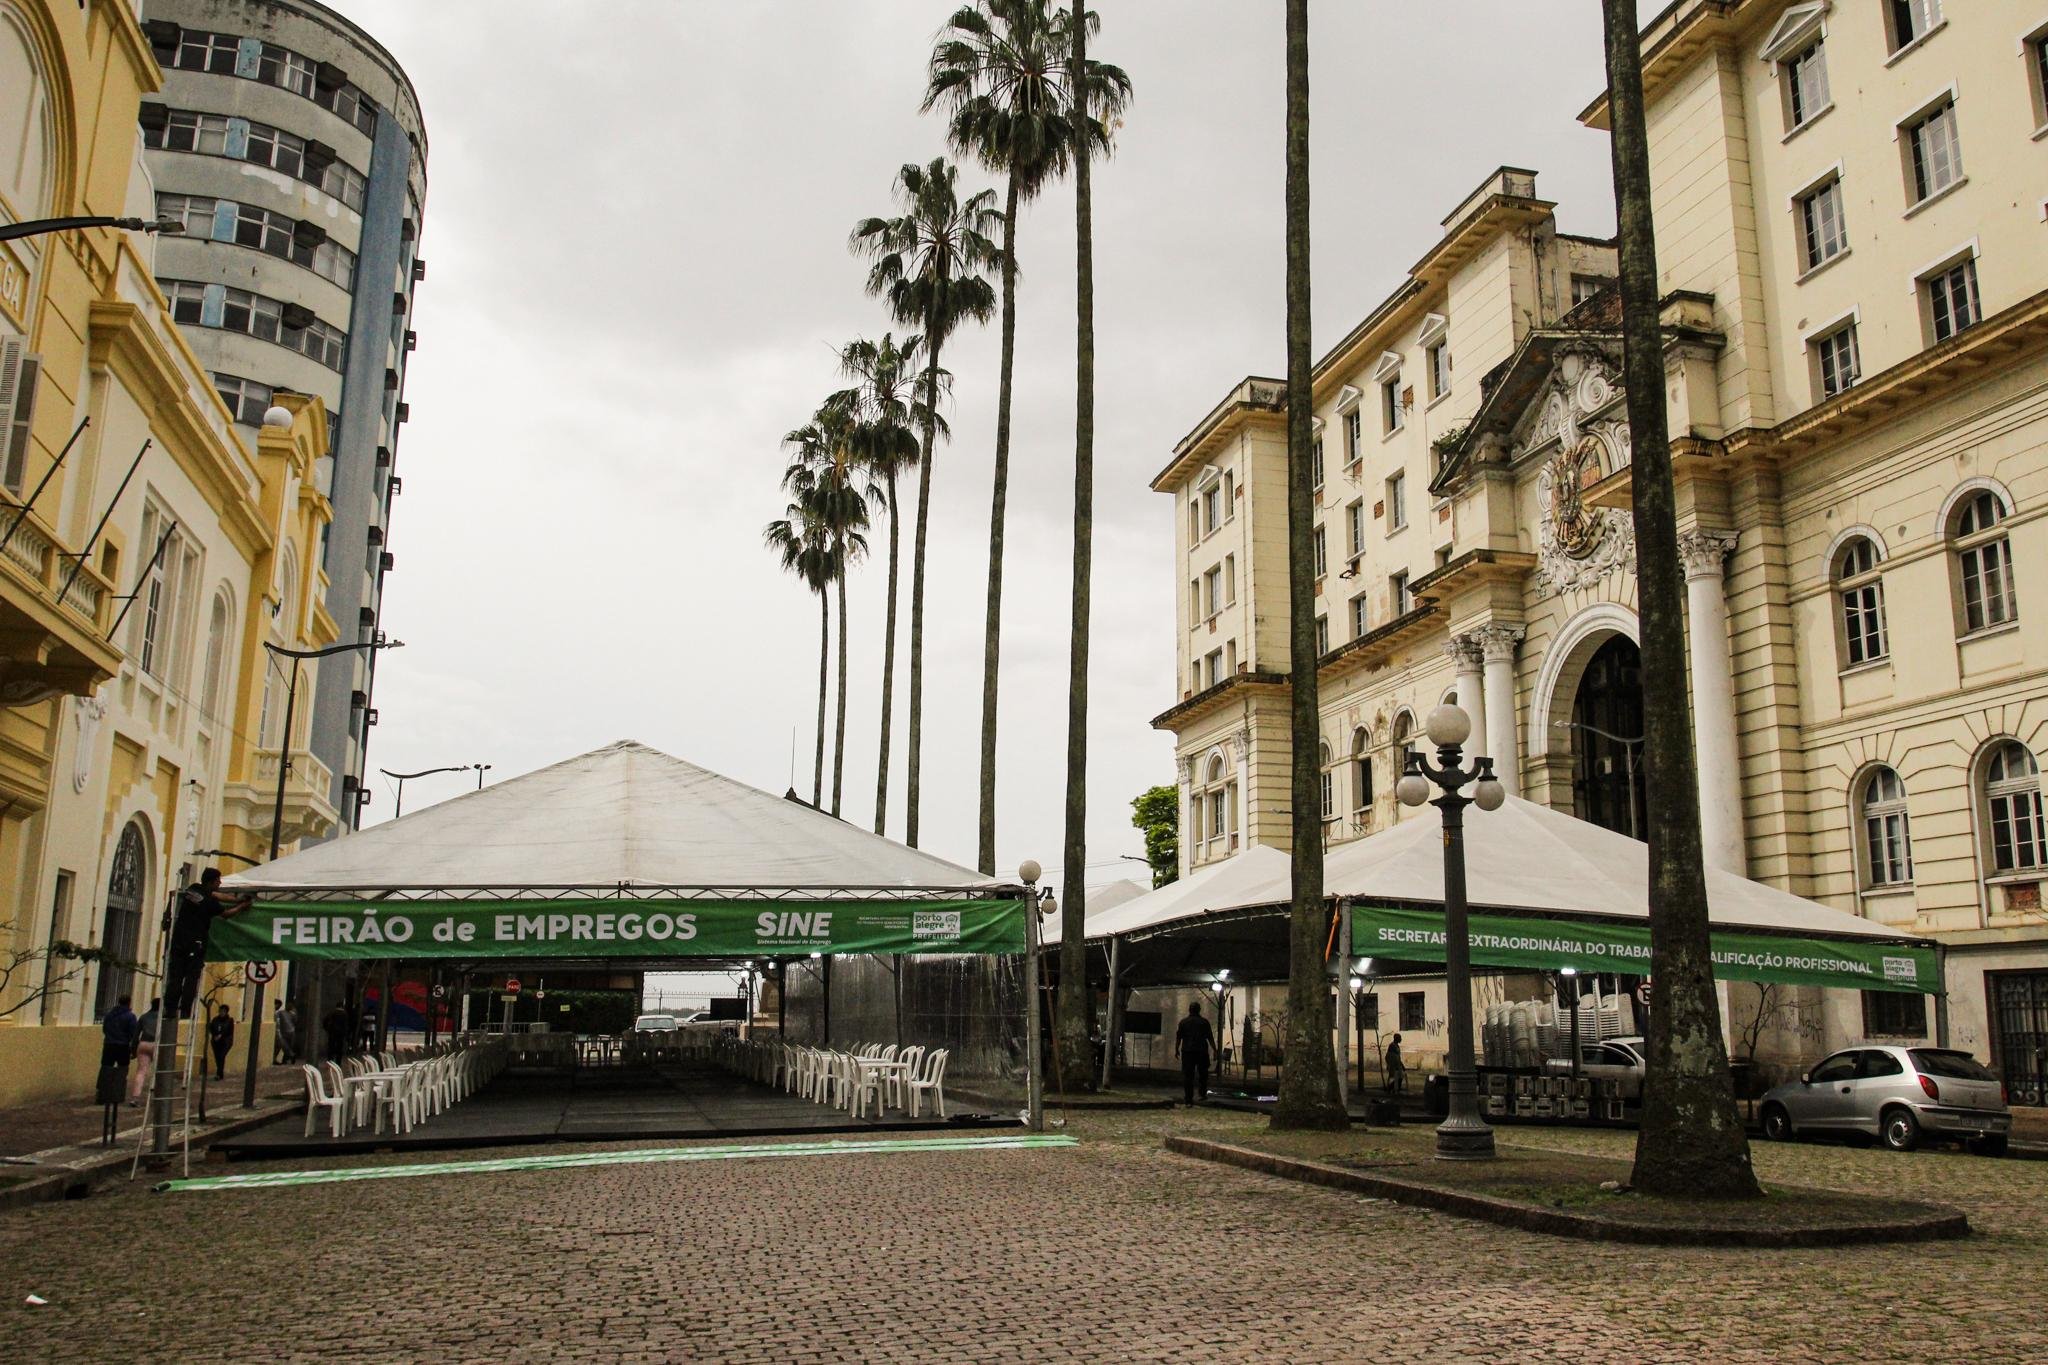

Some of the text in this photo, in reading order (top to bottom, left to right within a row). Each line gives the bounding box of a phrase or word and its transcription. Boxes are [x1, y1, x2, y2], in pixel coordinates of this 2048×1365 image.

[271, 908, 698, 944] FEIRÃO de EMPREGOS
[754, 911, 833, 936] SINE
[915, 914, 941, 922] porto
[915, 922, 944, 930] alegre
[1378, 927, 1872, 974] SECRETAR EXTRAORDINÁRIA DO TRABA ALIFICAÇÃO PROFISSIONAL
